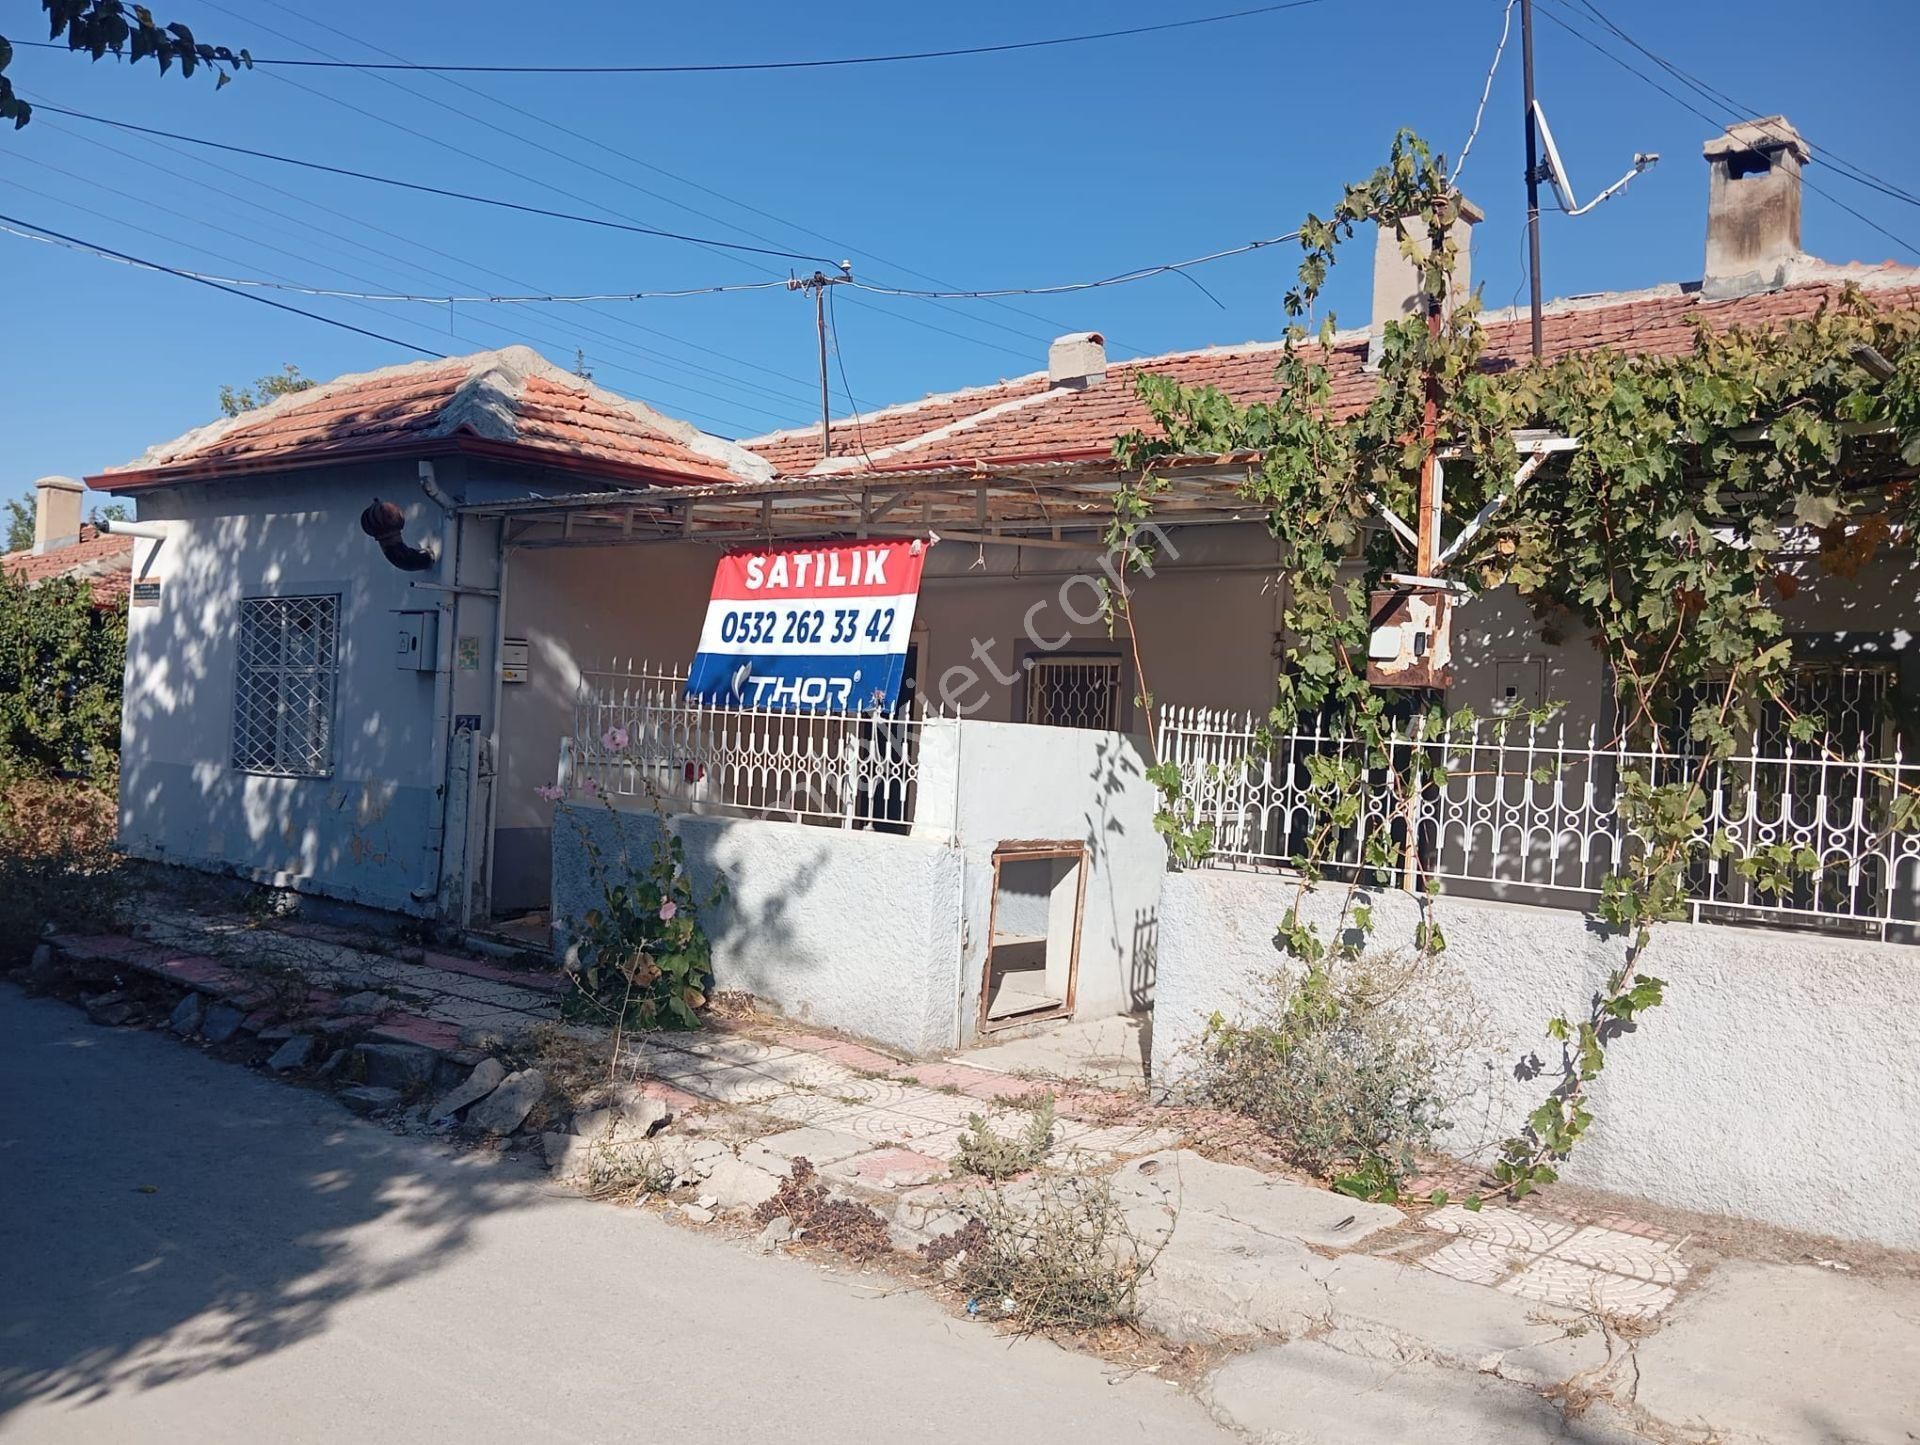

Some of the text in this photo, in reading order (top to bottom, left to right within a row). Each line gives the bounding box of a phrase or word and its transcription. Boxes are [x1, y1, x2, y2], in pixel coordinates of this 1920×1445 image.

[745, 549, 891, 589] SATILIK
[721, 608, 895, 643] 0532 262 33 42
[748, 676, 853, 704] THOR
